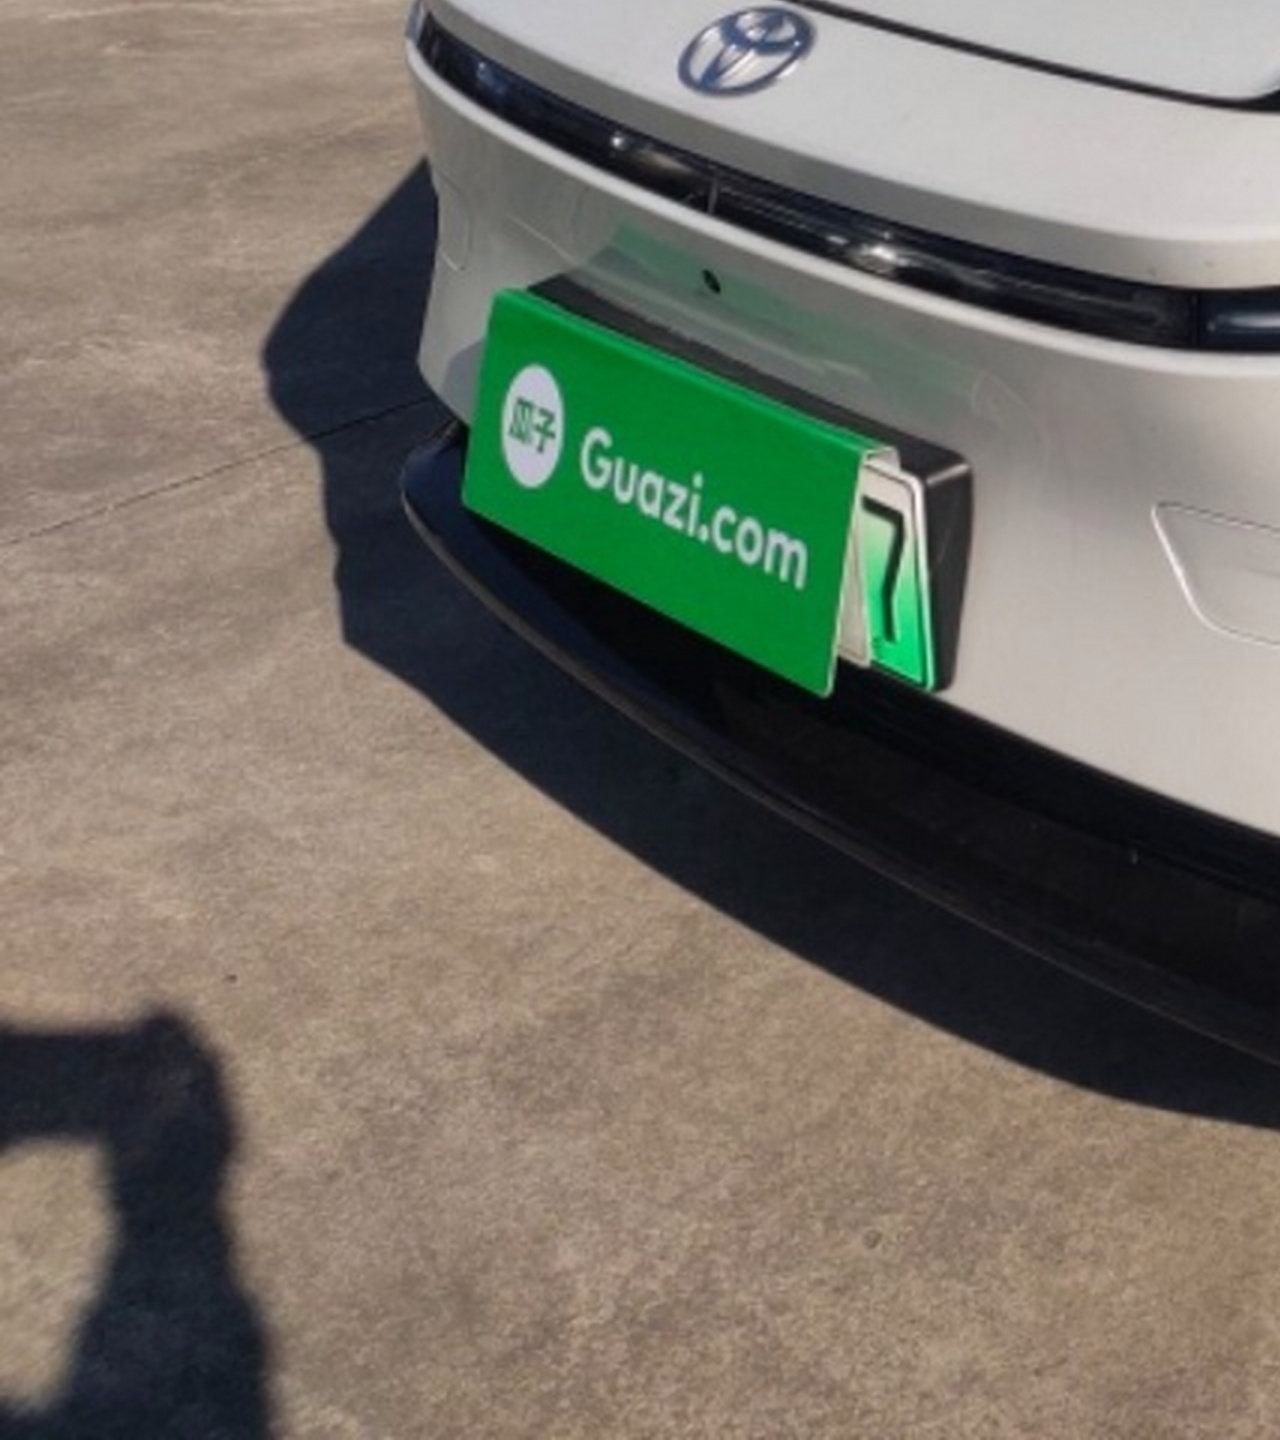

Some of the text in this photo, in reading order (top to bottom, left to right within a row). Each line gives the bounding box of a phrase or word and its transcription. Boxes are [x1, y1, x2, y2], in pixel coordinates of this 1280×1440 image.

[509, 396, 556, 454] 瓜子
[580, 426, 808, 590] Guazi.com
[861, 494, 907, 644] 7
